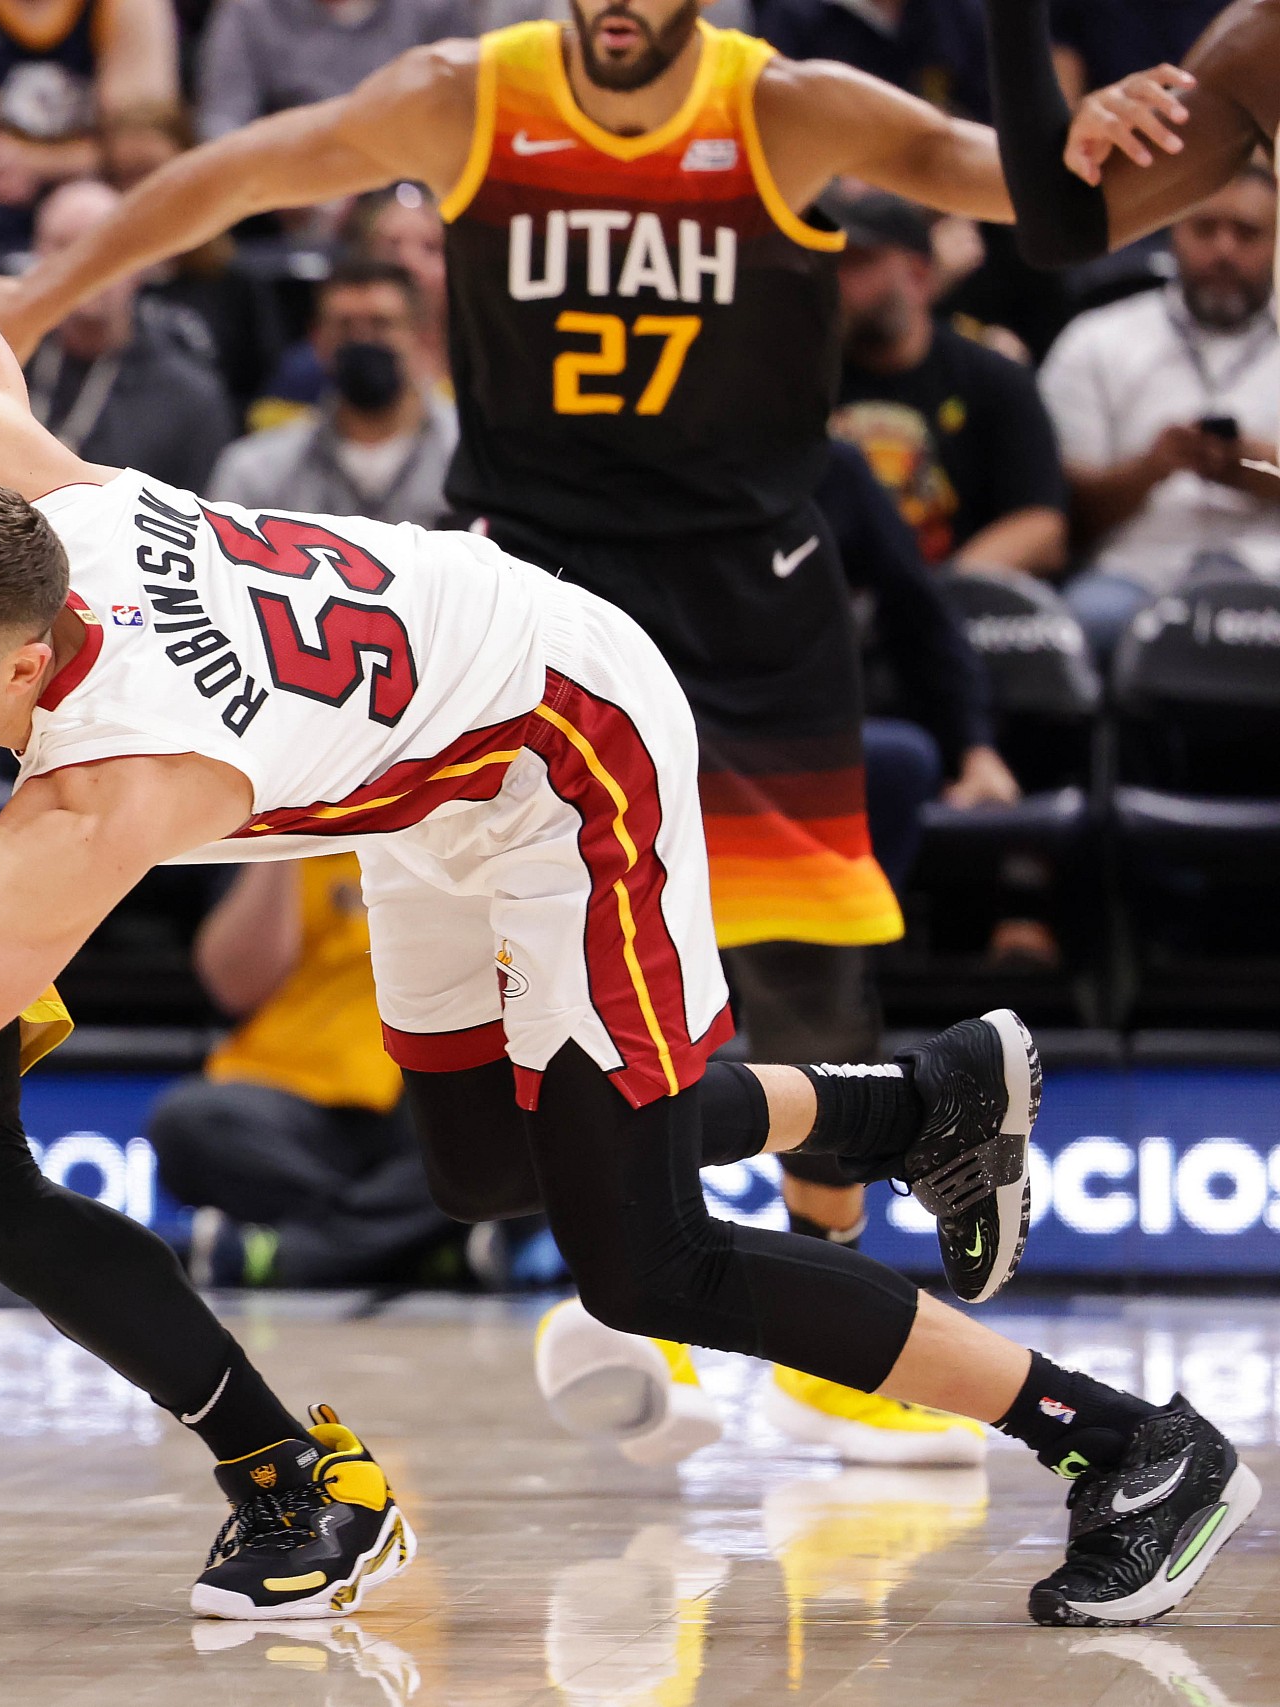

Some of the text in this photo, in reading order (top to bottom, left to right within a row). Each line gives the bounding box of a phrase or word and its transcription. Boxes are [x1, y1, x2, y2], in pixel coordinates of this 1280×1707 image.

[509, 209, 737, 305] UTAH
[553, 310, 702, 416] 27
[134, 487, 270, 738] ROBINSON
[194, 498, 418, 728] 55
